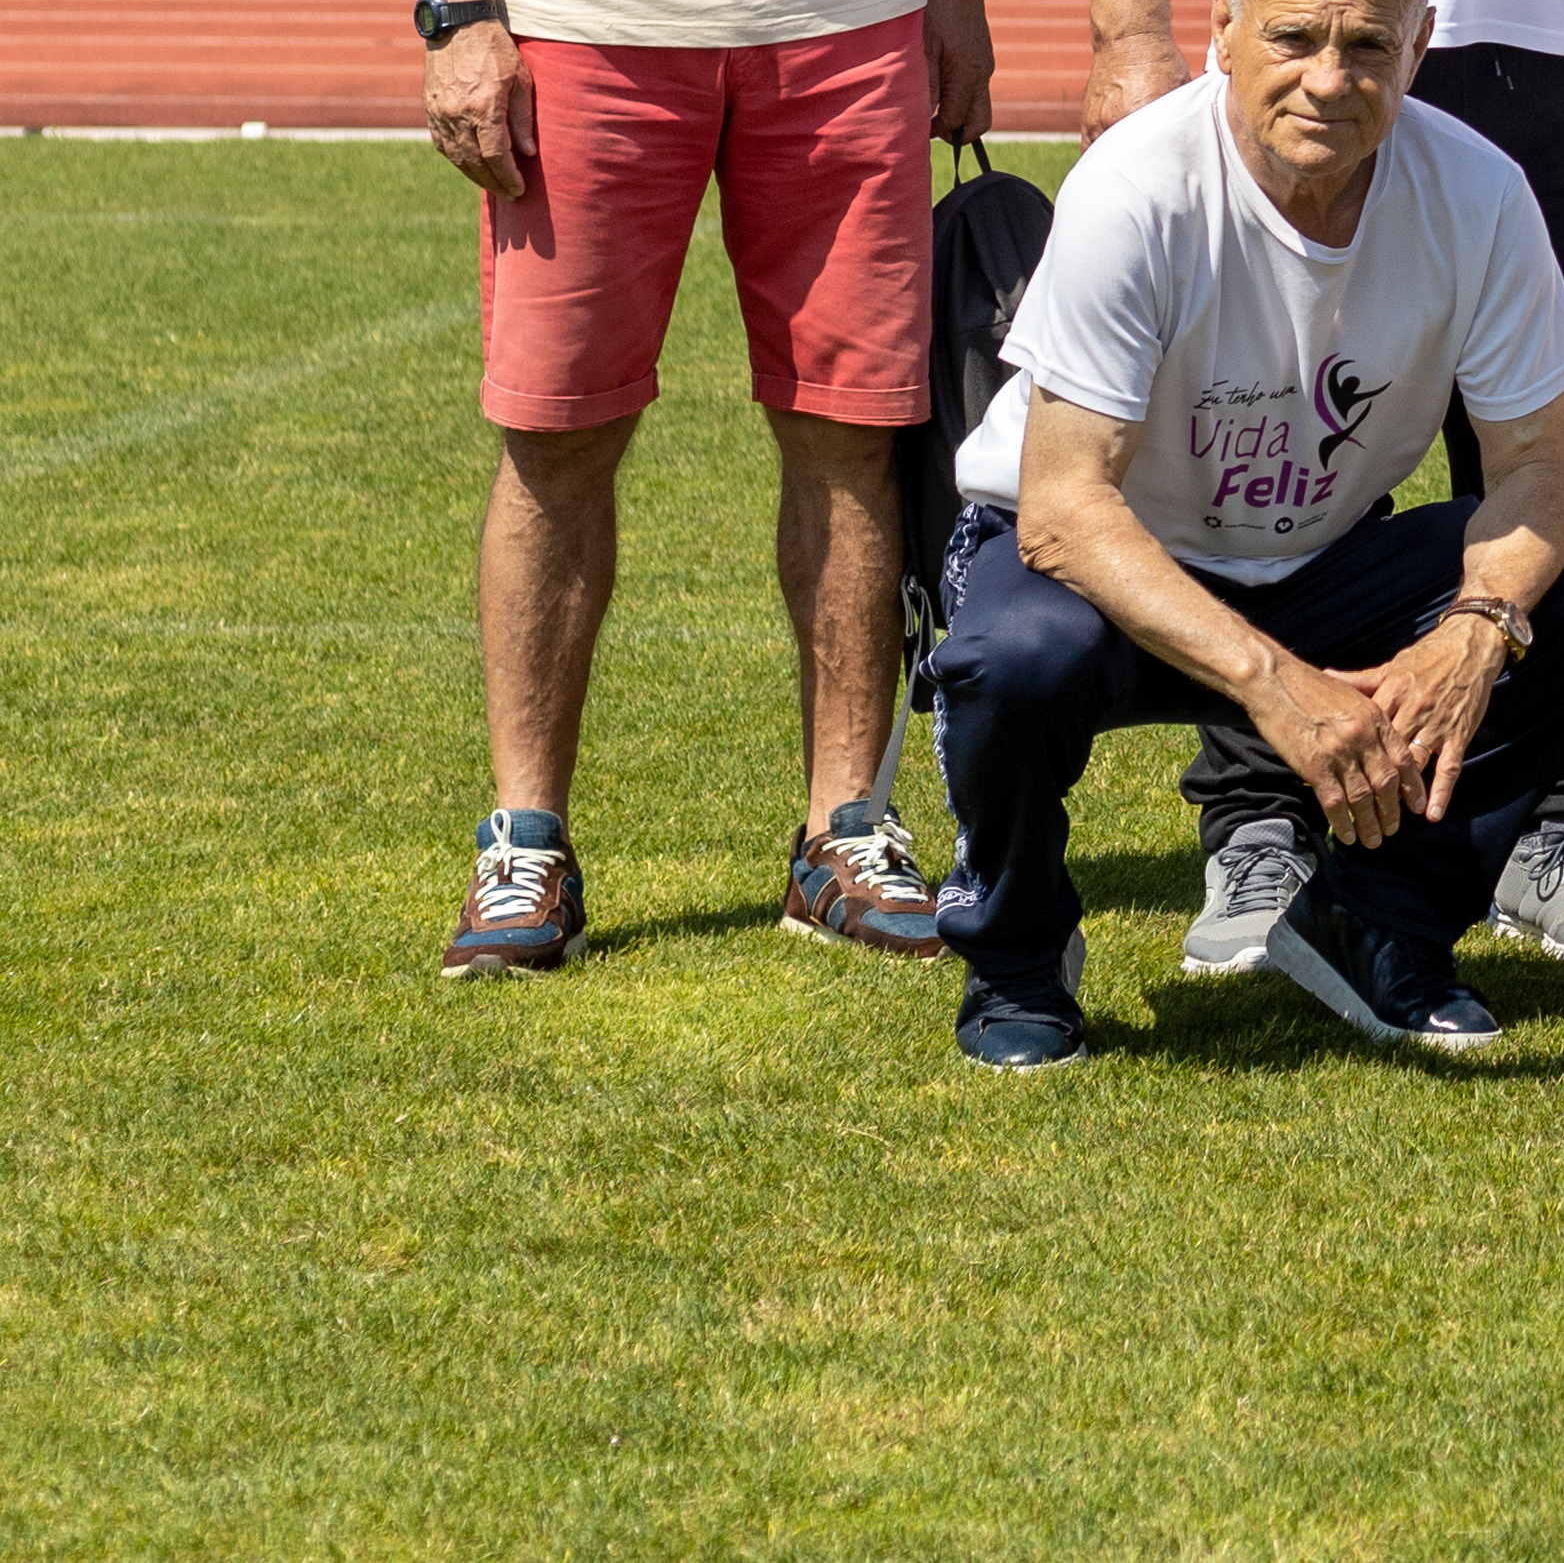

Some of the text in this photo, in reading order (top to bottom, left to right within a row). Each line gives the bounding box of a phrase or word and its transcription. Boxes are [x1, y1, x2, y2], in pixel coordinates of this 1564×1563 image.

[1225, 381, 1265, 407] tenho
[1190, 415, 1290, 461] Vida
[1212, 460, 1338, 508] Feliz
